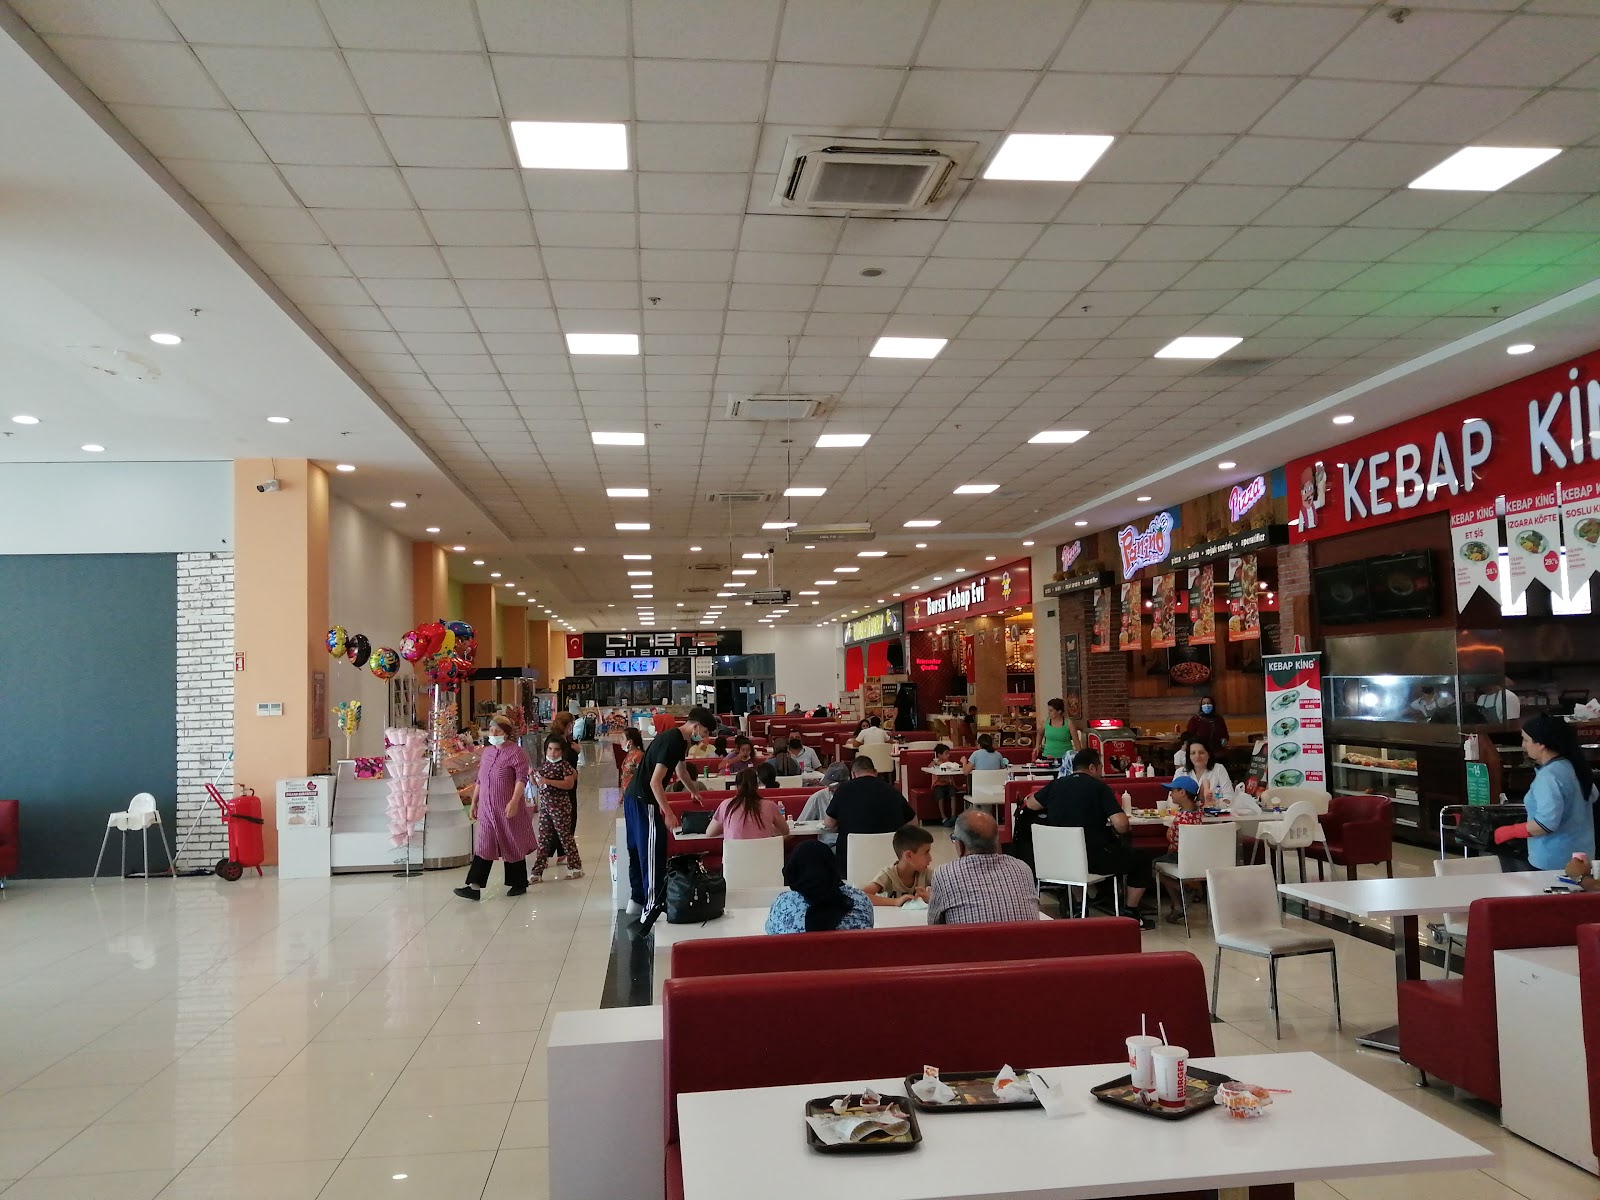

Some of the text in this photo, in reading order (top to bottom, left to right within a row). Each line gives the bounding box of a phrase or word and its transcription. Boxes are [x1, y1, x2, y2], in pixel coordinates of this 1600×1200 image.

[1342, 419, 1492, 522] KEBAP
[1230, 479, 1263, 522] Pizza
[1506, 492, 1555, 512] KEBAP KİNG
[1563, 484, 1593, 501] KEBAP
[1451, 506, 1494, 525] KEBAP KİNG
[1507, 513, 1557, 529] IZGARA KÖFTE
[1566, 505, 1592, 518] SOSLU
[1120, 522, 1168, 574] Panino
[926, 578, 985, 616] Bursa Kebap Evi
[602, 660, 659, 673] TICKET
[1268, 659, 1314, 671] KEBAP KİNG
[1177, 1060, 1185, 1098] BURGER
